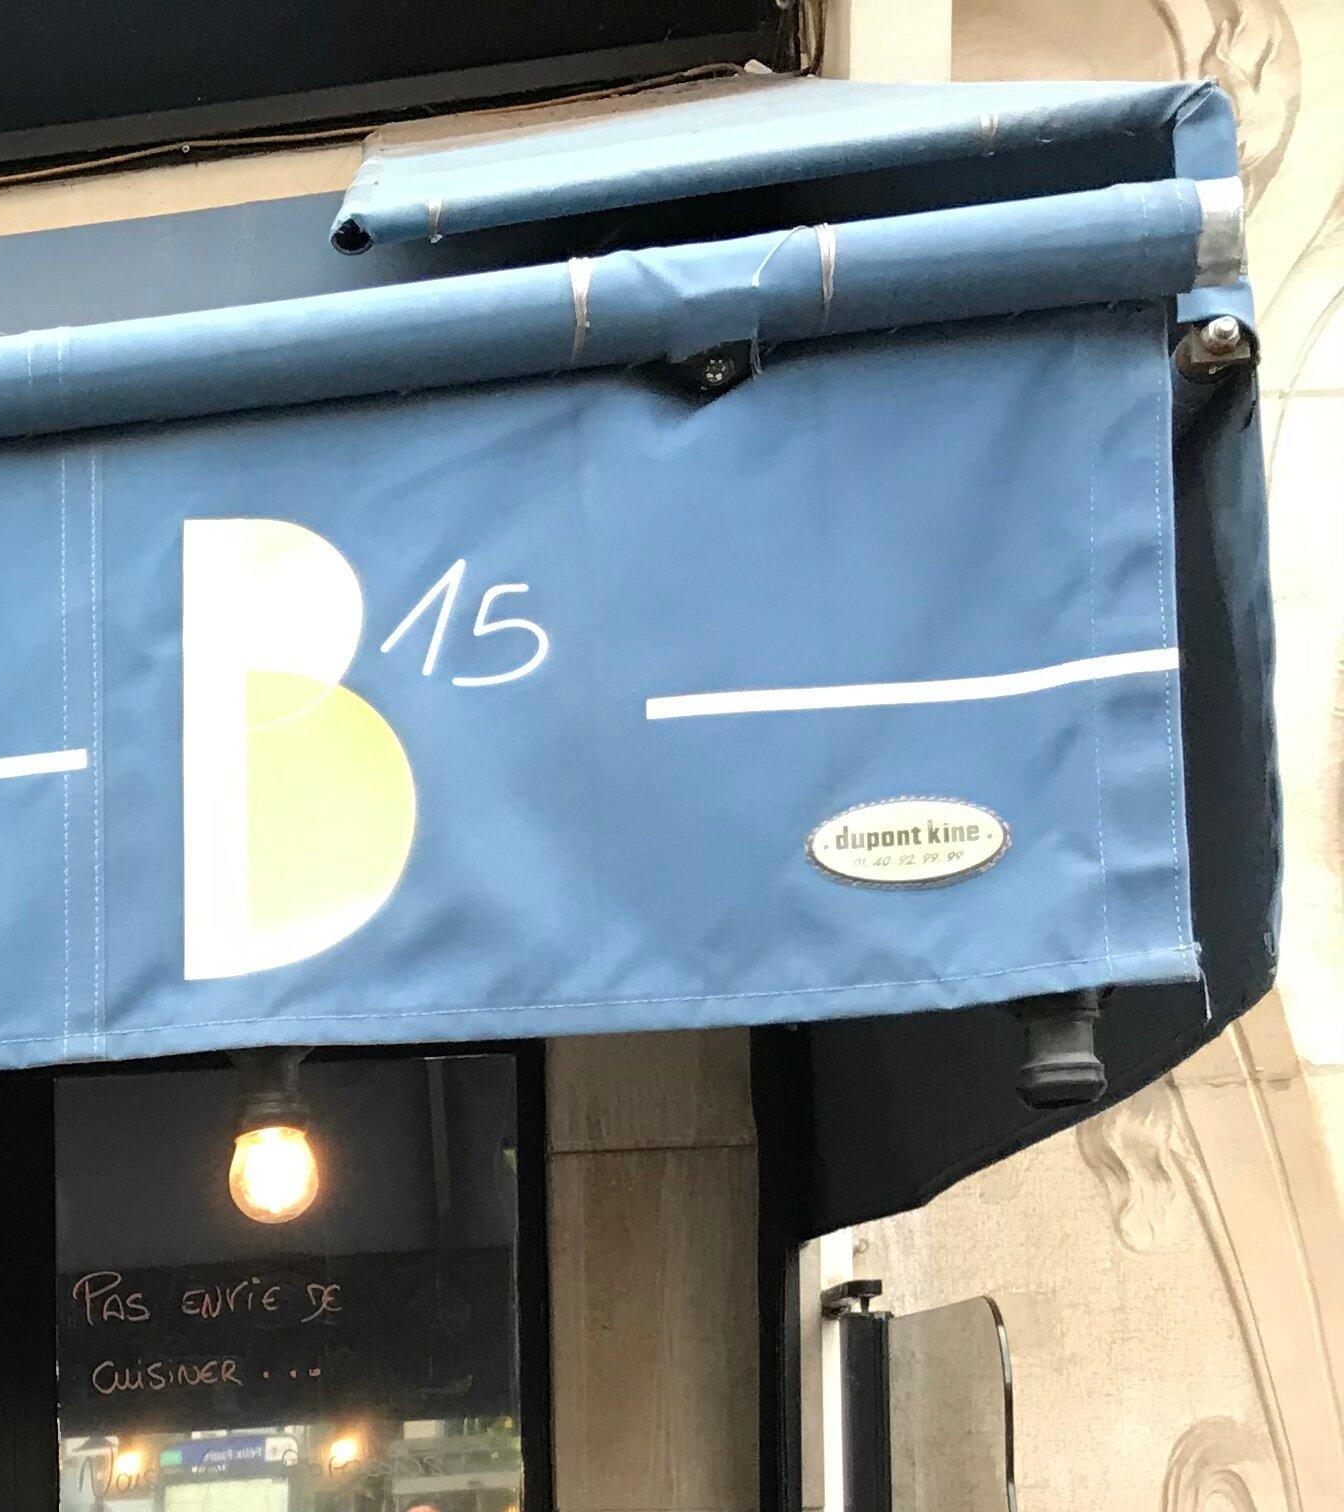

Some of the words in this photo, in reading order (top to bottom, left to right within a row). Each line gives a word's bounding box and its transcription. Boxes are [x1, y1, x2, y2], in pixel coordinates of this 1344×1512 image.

[183, 517, 417, 980] B
[380, 559, 550, 687] 15
[835, 826, 922, 852] dupont
[926, 819, 980, 845] kine
[72, 1271, 150, 1326] PAS
[182, 1277, 281, 1318] ENVIE
[301, 1284, 343, 1324] DE
[92, 1358, 243, 1395] CUISINER
